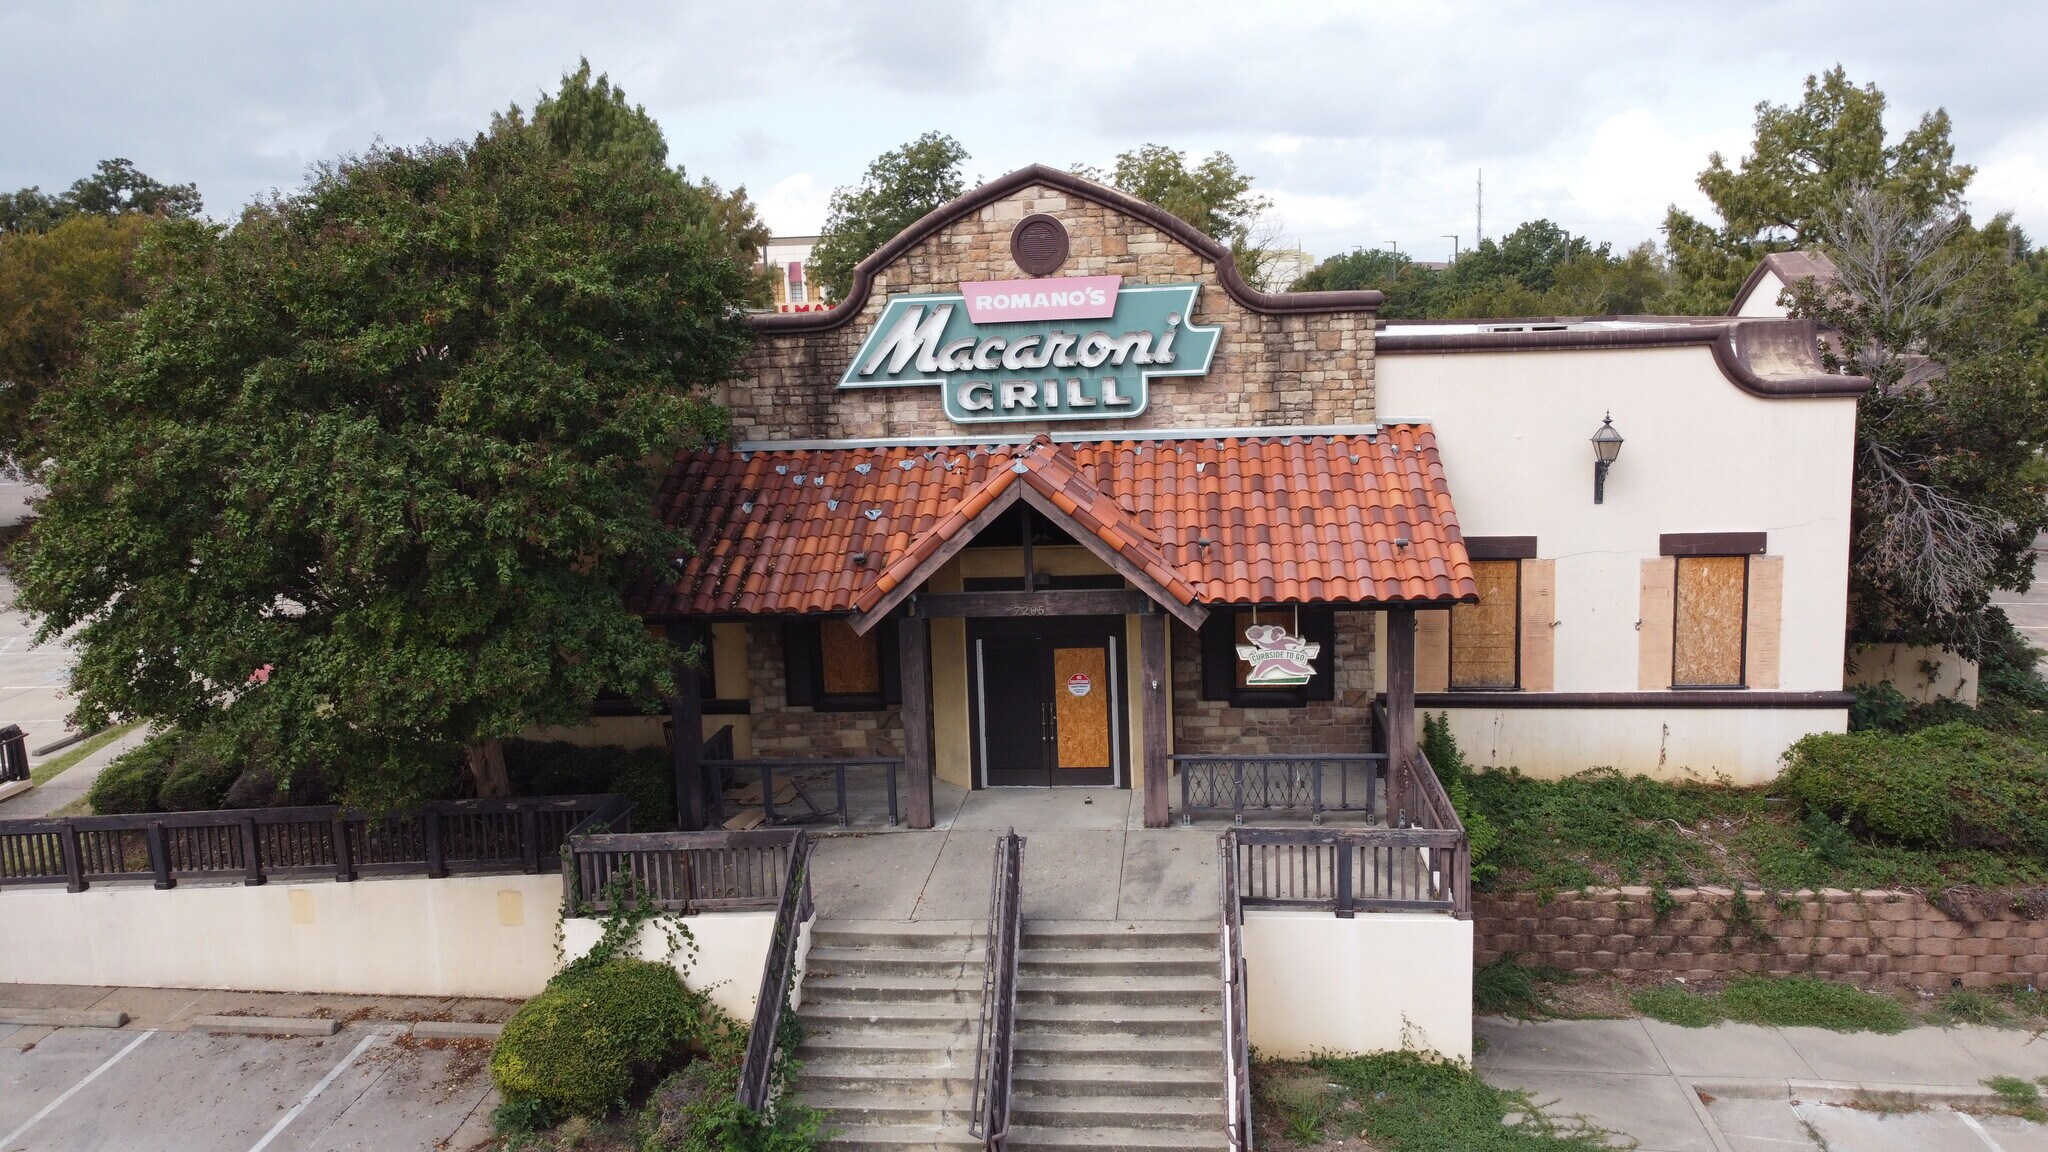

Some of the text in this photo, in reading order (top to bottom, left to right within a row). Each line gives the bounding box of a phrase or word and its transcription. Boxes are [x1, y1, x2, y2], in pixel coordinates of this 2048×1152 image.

[975, 286, 1107, 311] ROMANO'S
[857, 303, 1182, 376] Macaroni
[956, 376, 1132, 411] GRILL
[1014, 605, 1045, 616] 7205
[1251, 651, 1305, 662] CURBSIDE TO GO
